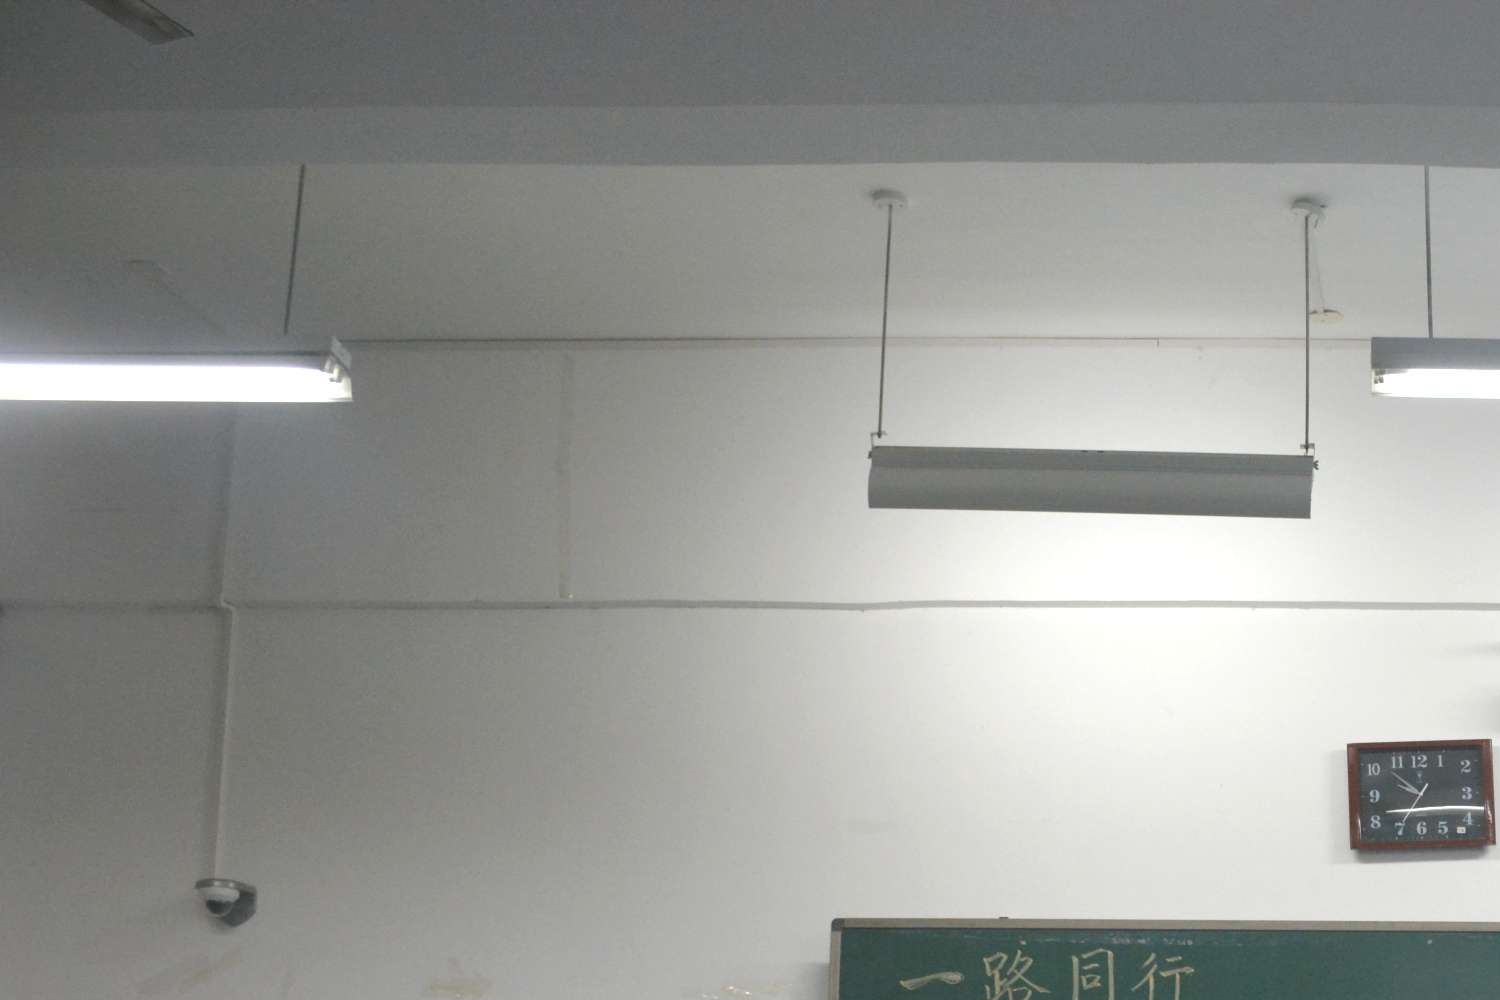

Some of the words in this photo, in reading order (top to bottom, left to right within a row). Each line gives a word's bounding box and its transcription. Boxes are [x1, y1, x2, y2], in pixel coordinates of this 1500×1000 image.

[1367, 762, 1381, 776] 10
[1391, 755, 1403, 769] 11
[1411, 754, 1428, 768] 12
[1437, 754, 1444, 768] 1
[1460, 759, 1472, 773] 2
[1369, 789, 1380, 803] 9
[1461, 786, 1473, 800] 3
[1370, 815, 1381, 829] 8
[1394, 822, 1405, 836] 7
[1416, 821, 1428, 835] 6
[1438, 821, 1449, 835] 5
[1462, 811, 1473, 826] 4
